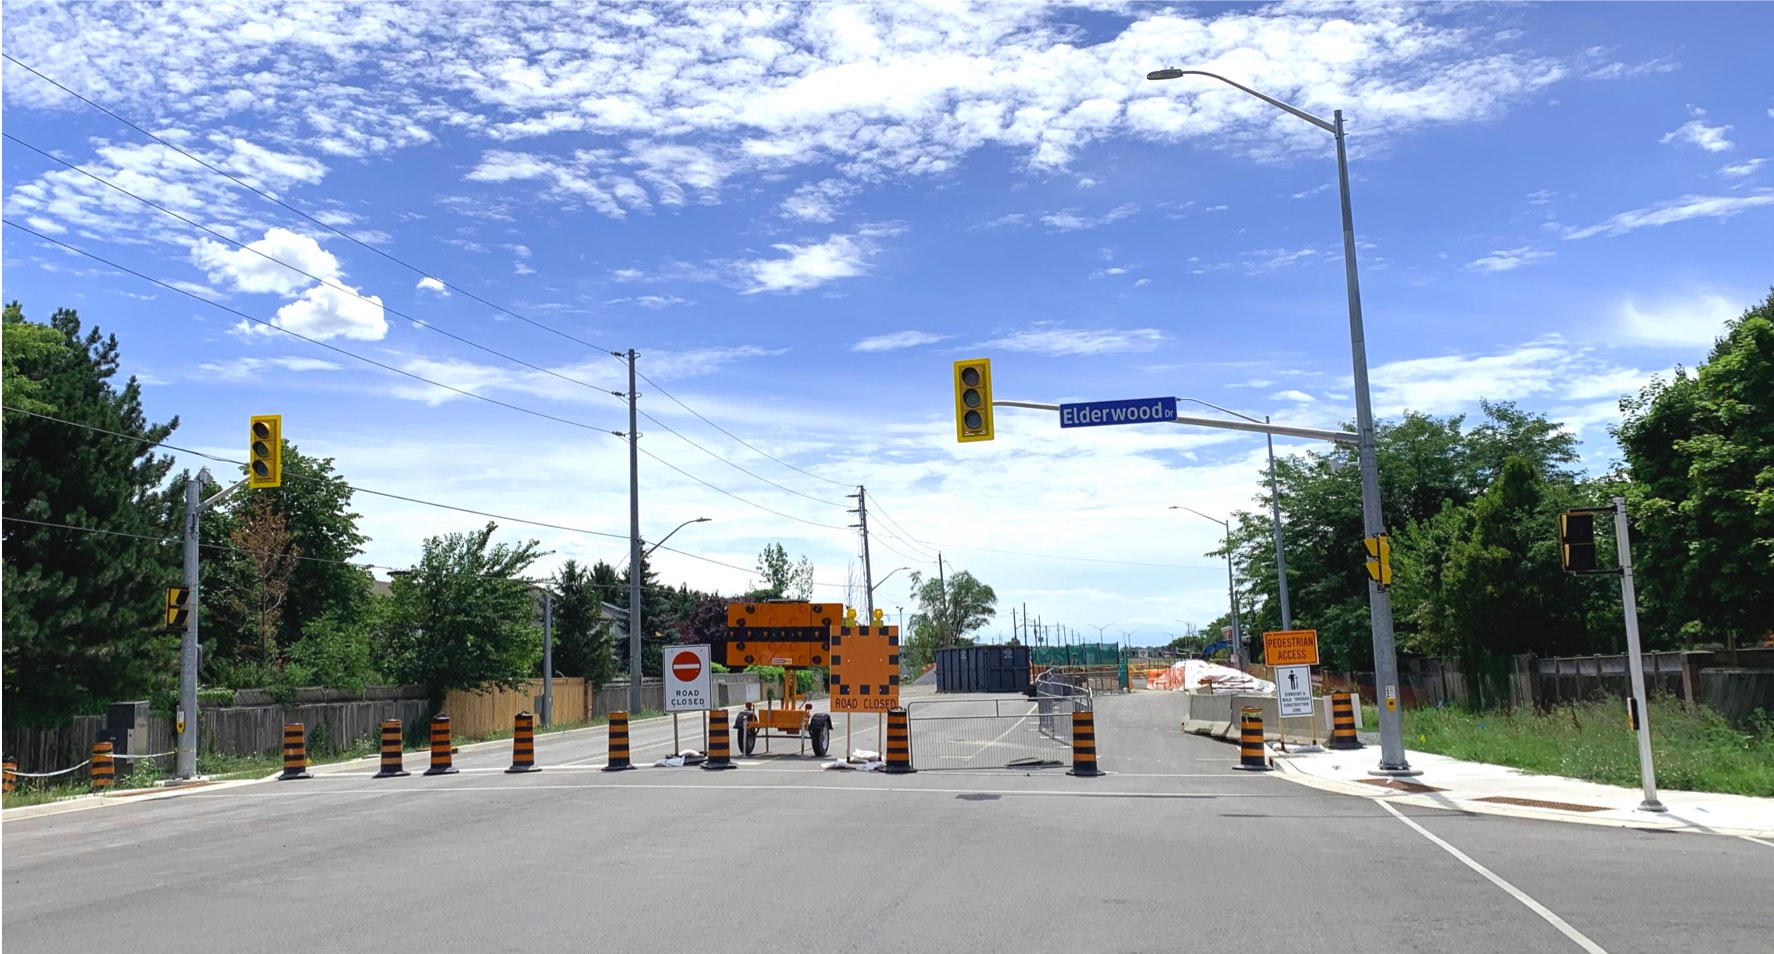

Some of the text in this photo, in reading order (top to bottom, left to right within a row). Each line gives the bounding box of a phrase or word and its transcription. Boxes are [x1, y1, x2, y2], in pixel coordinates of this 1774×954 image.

[1063, 402, 1174, 425] Elderwood Dr
[1268, 637, 1314, 648] PEDESTRIAN
[1278, 649, 1307, 660] ACCESS
[671, 698, 705, 706] CLOSED
[835, 698, 897, 709] ROAD CLOSED
